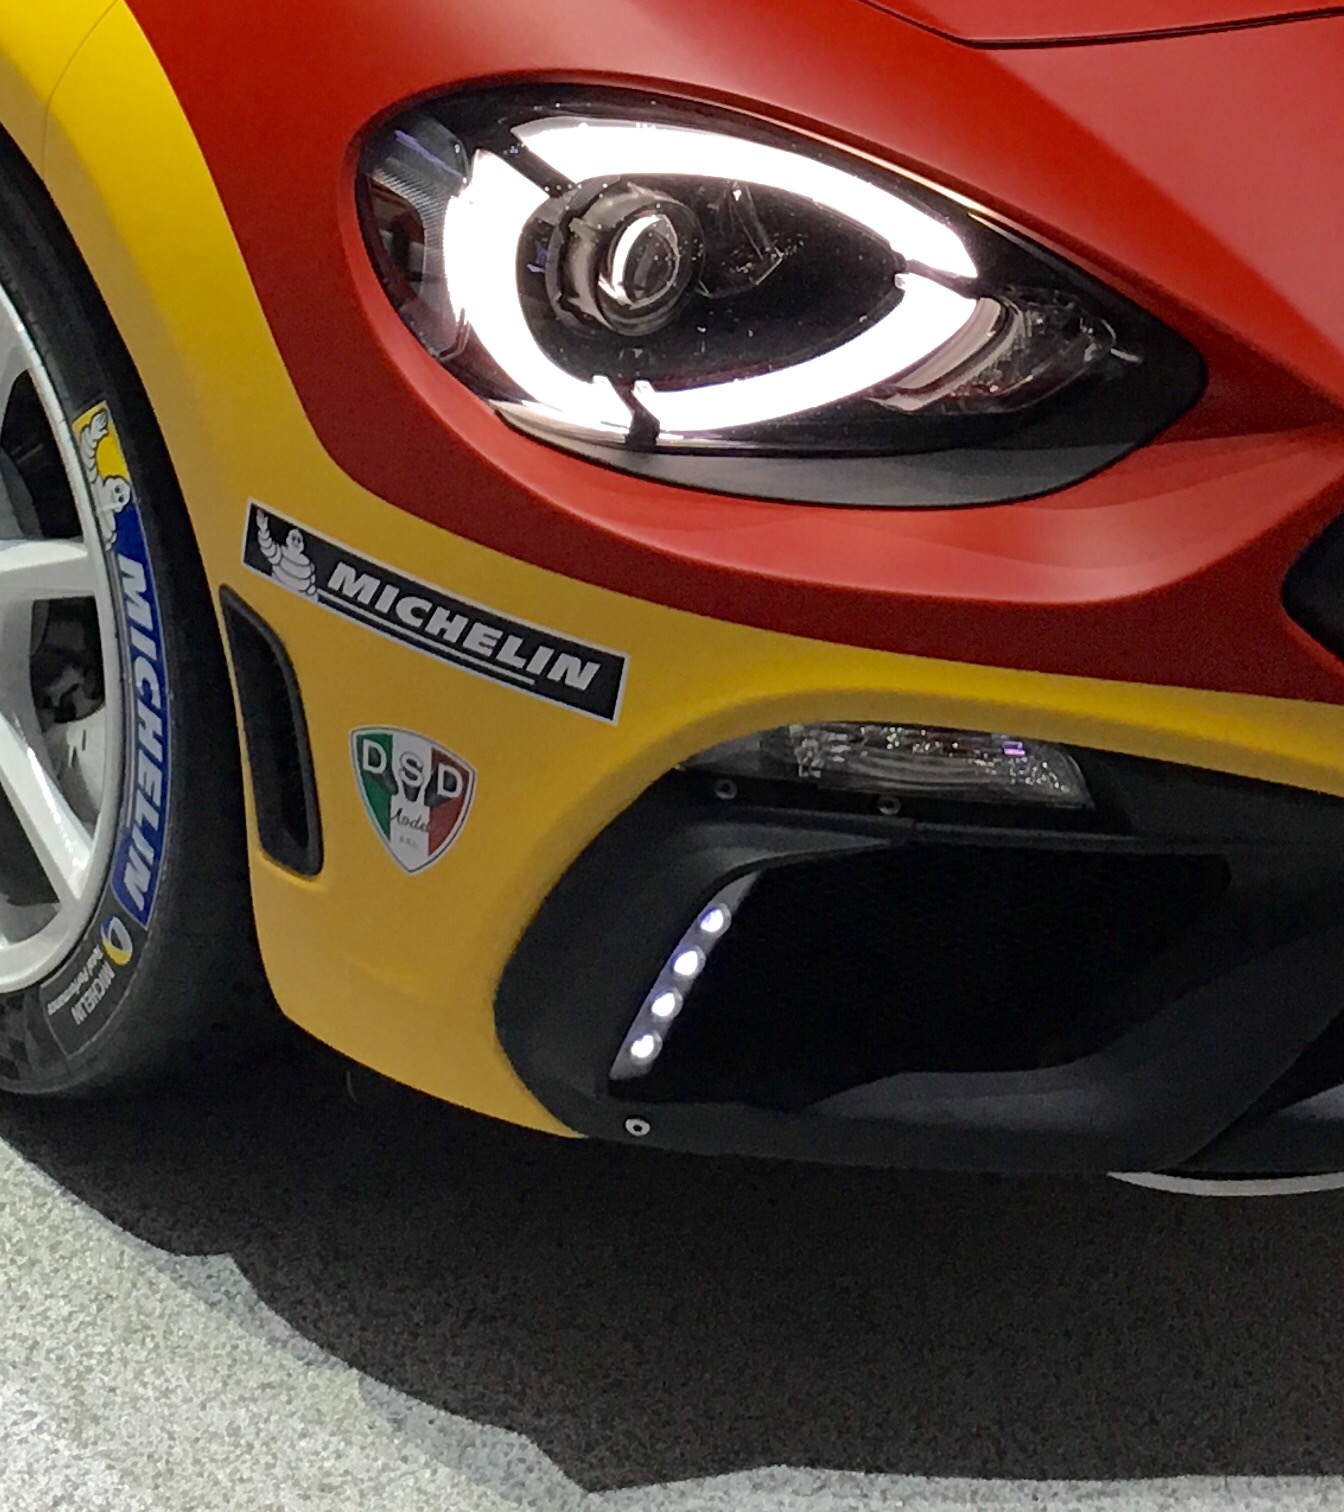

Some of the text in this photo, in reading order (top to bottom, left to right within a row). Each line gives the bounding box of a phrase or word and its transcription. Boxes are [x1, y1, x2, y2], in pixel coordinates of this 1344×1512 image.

[326, 561, 601, 691] MICHELIN
[116, 552, 167, 916] MICHELIN
[361, 738, 464, 799] DSD
[71, 959, 116, 1026] MICHELIN
